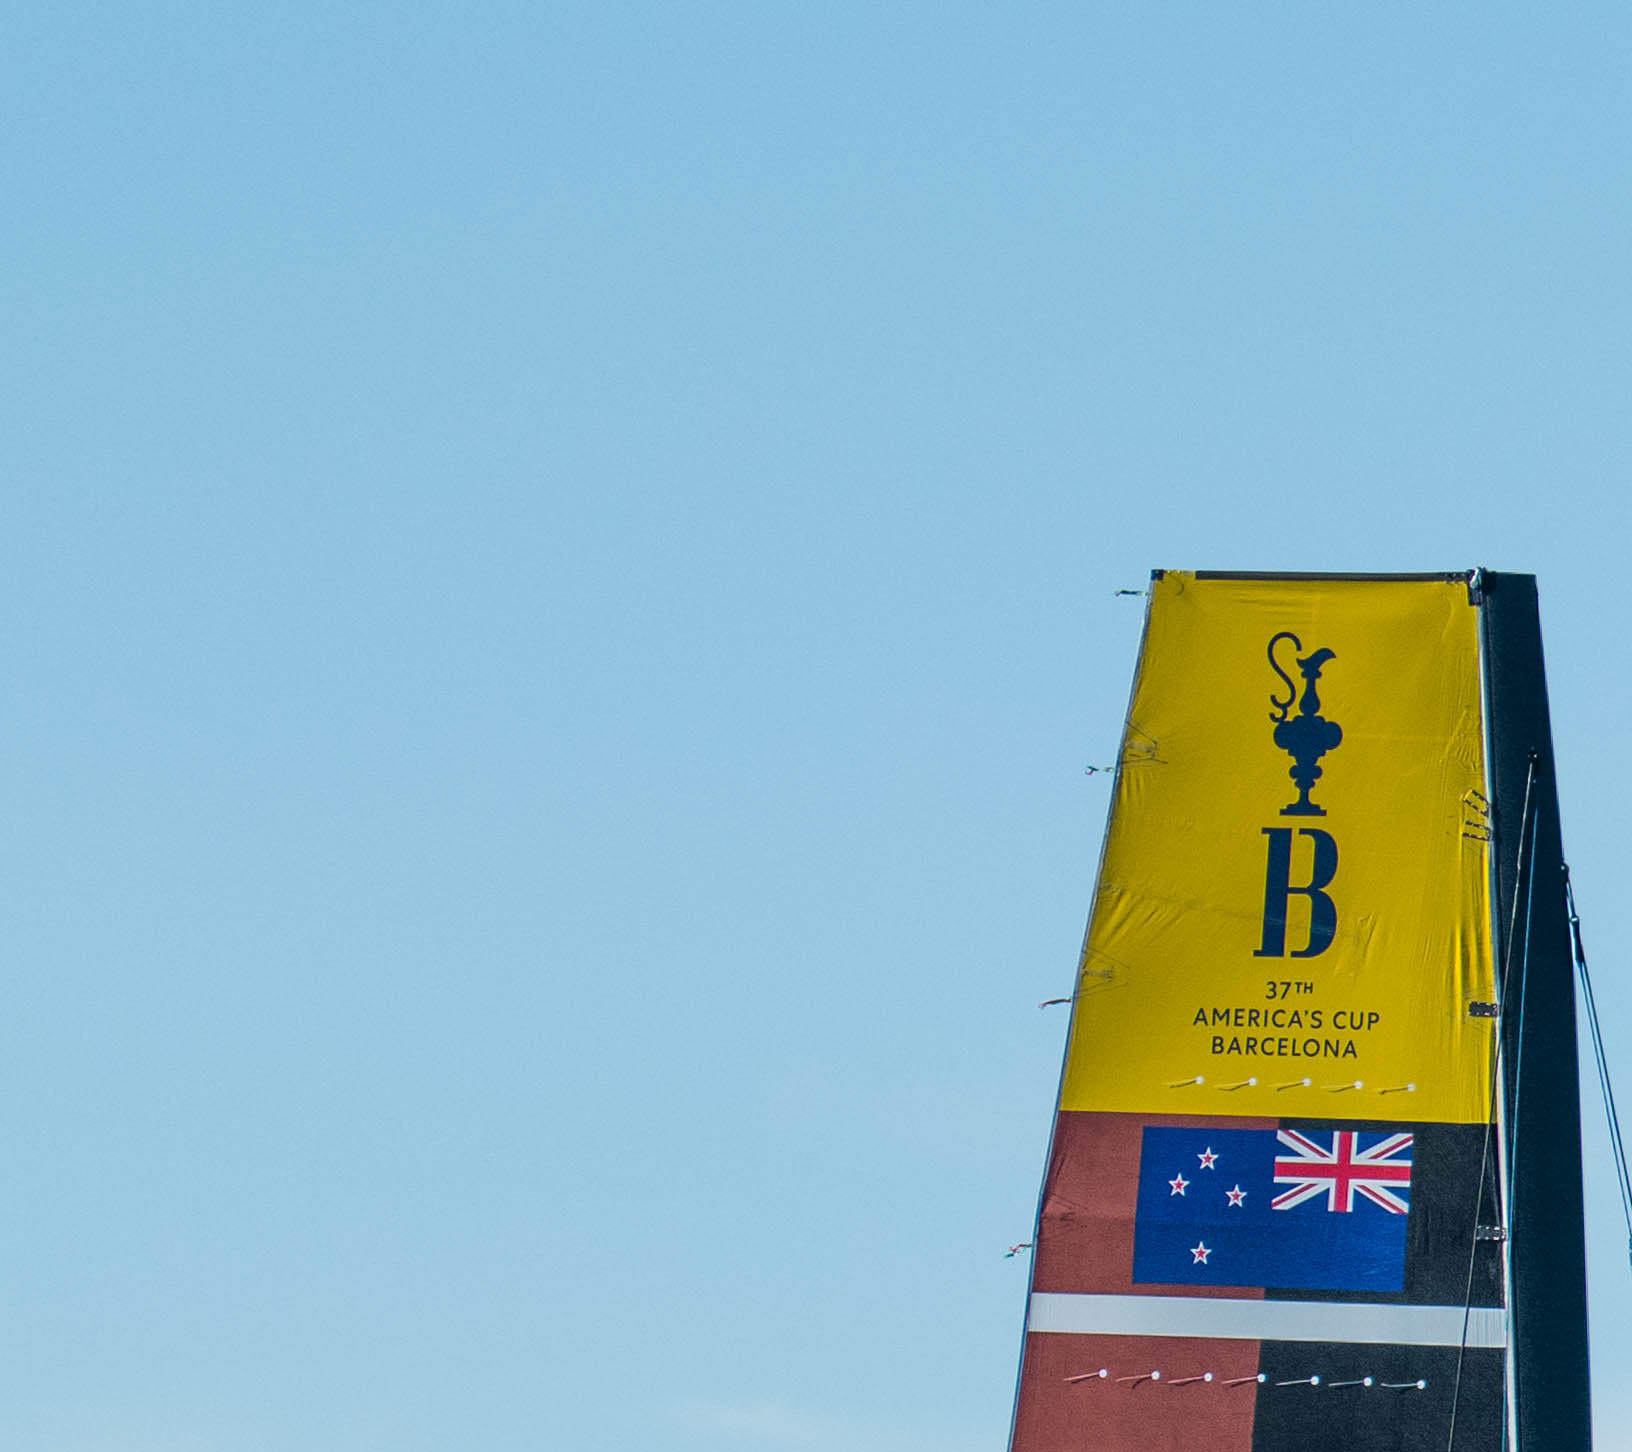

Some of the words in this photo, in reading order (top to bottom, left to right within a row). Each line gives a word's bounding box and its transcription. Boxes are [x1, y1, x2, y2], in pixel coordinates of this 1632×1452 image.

[1264, 980, 1315, 1002] 37TH
[1192, 1007, 1323, 1031] AMERICA'S
[1331, 1010, 1381, 1032] CUP
[1210, 1036, 1359, 1060] BARCELONA
